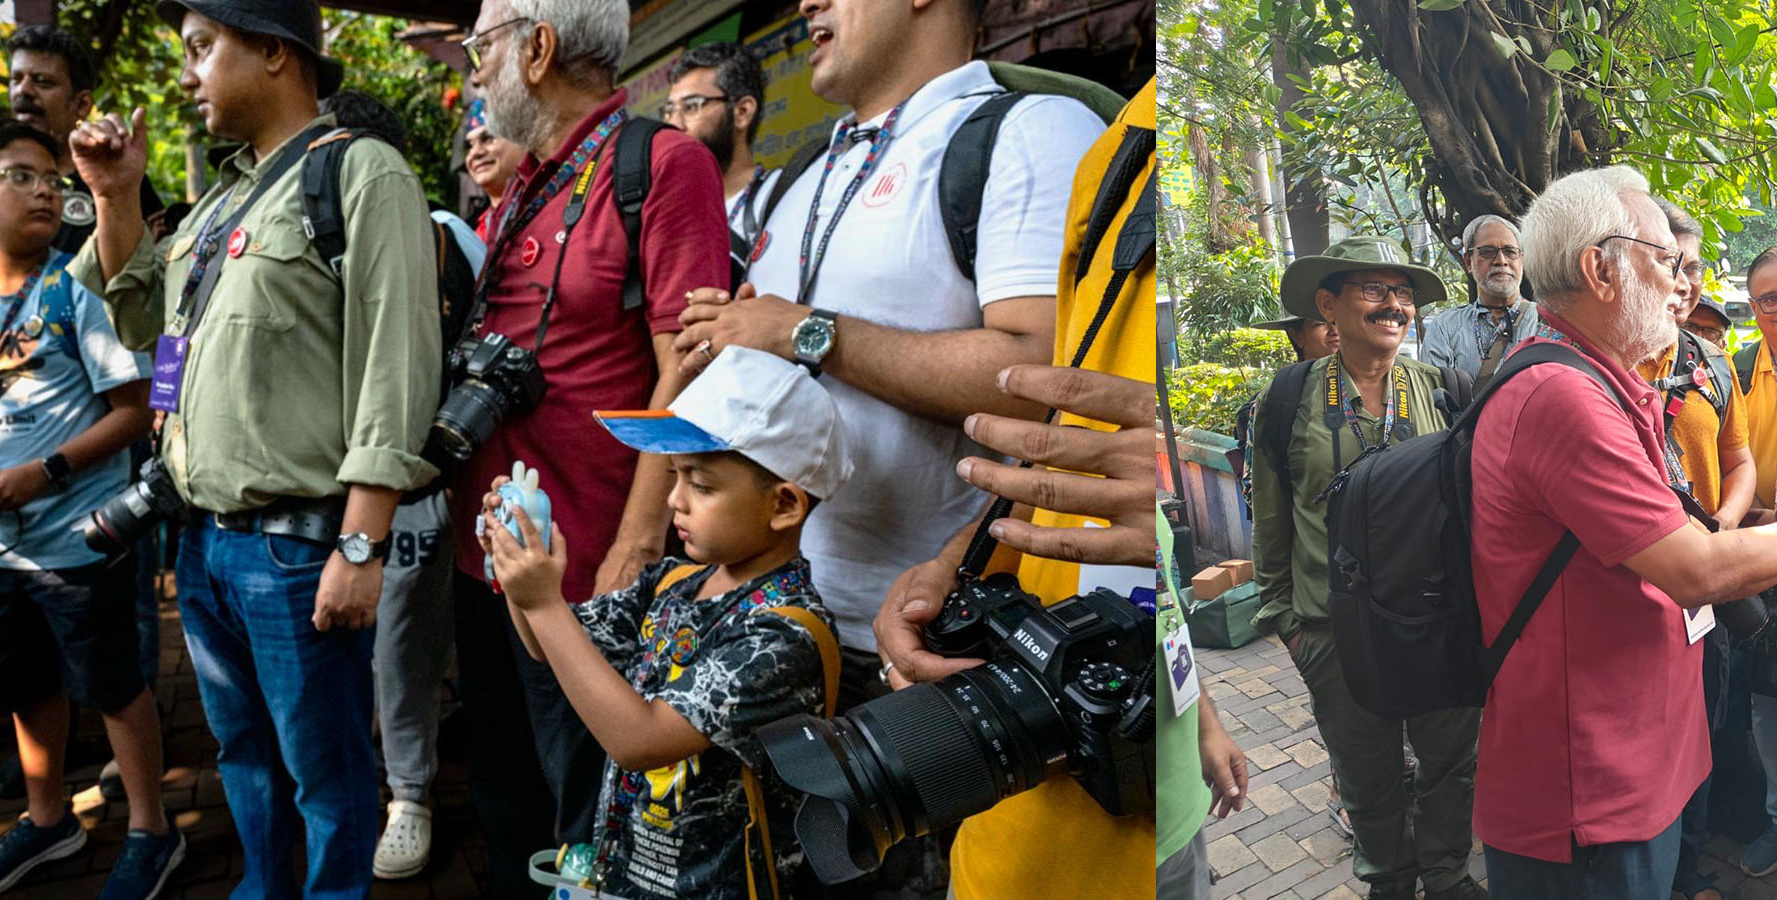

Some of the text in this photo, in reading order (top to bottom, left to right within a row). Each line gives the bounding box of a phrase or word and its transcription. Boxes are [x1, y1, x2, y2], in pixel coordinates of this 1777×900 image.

[1328, 376, 1339, 406] Nikon
[1396, 365, 1409, 419] Nikon D750
[1014, 628, 1049, 661] Nikon
